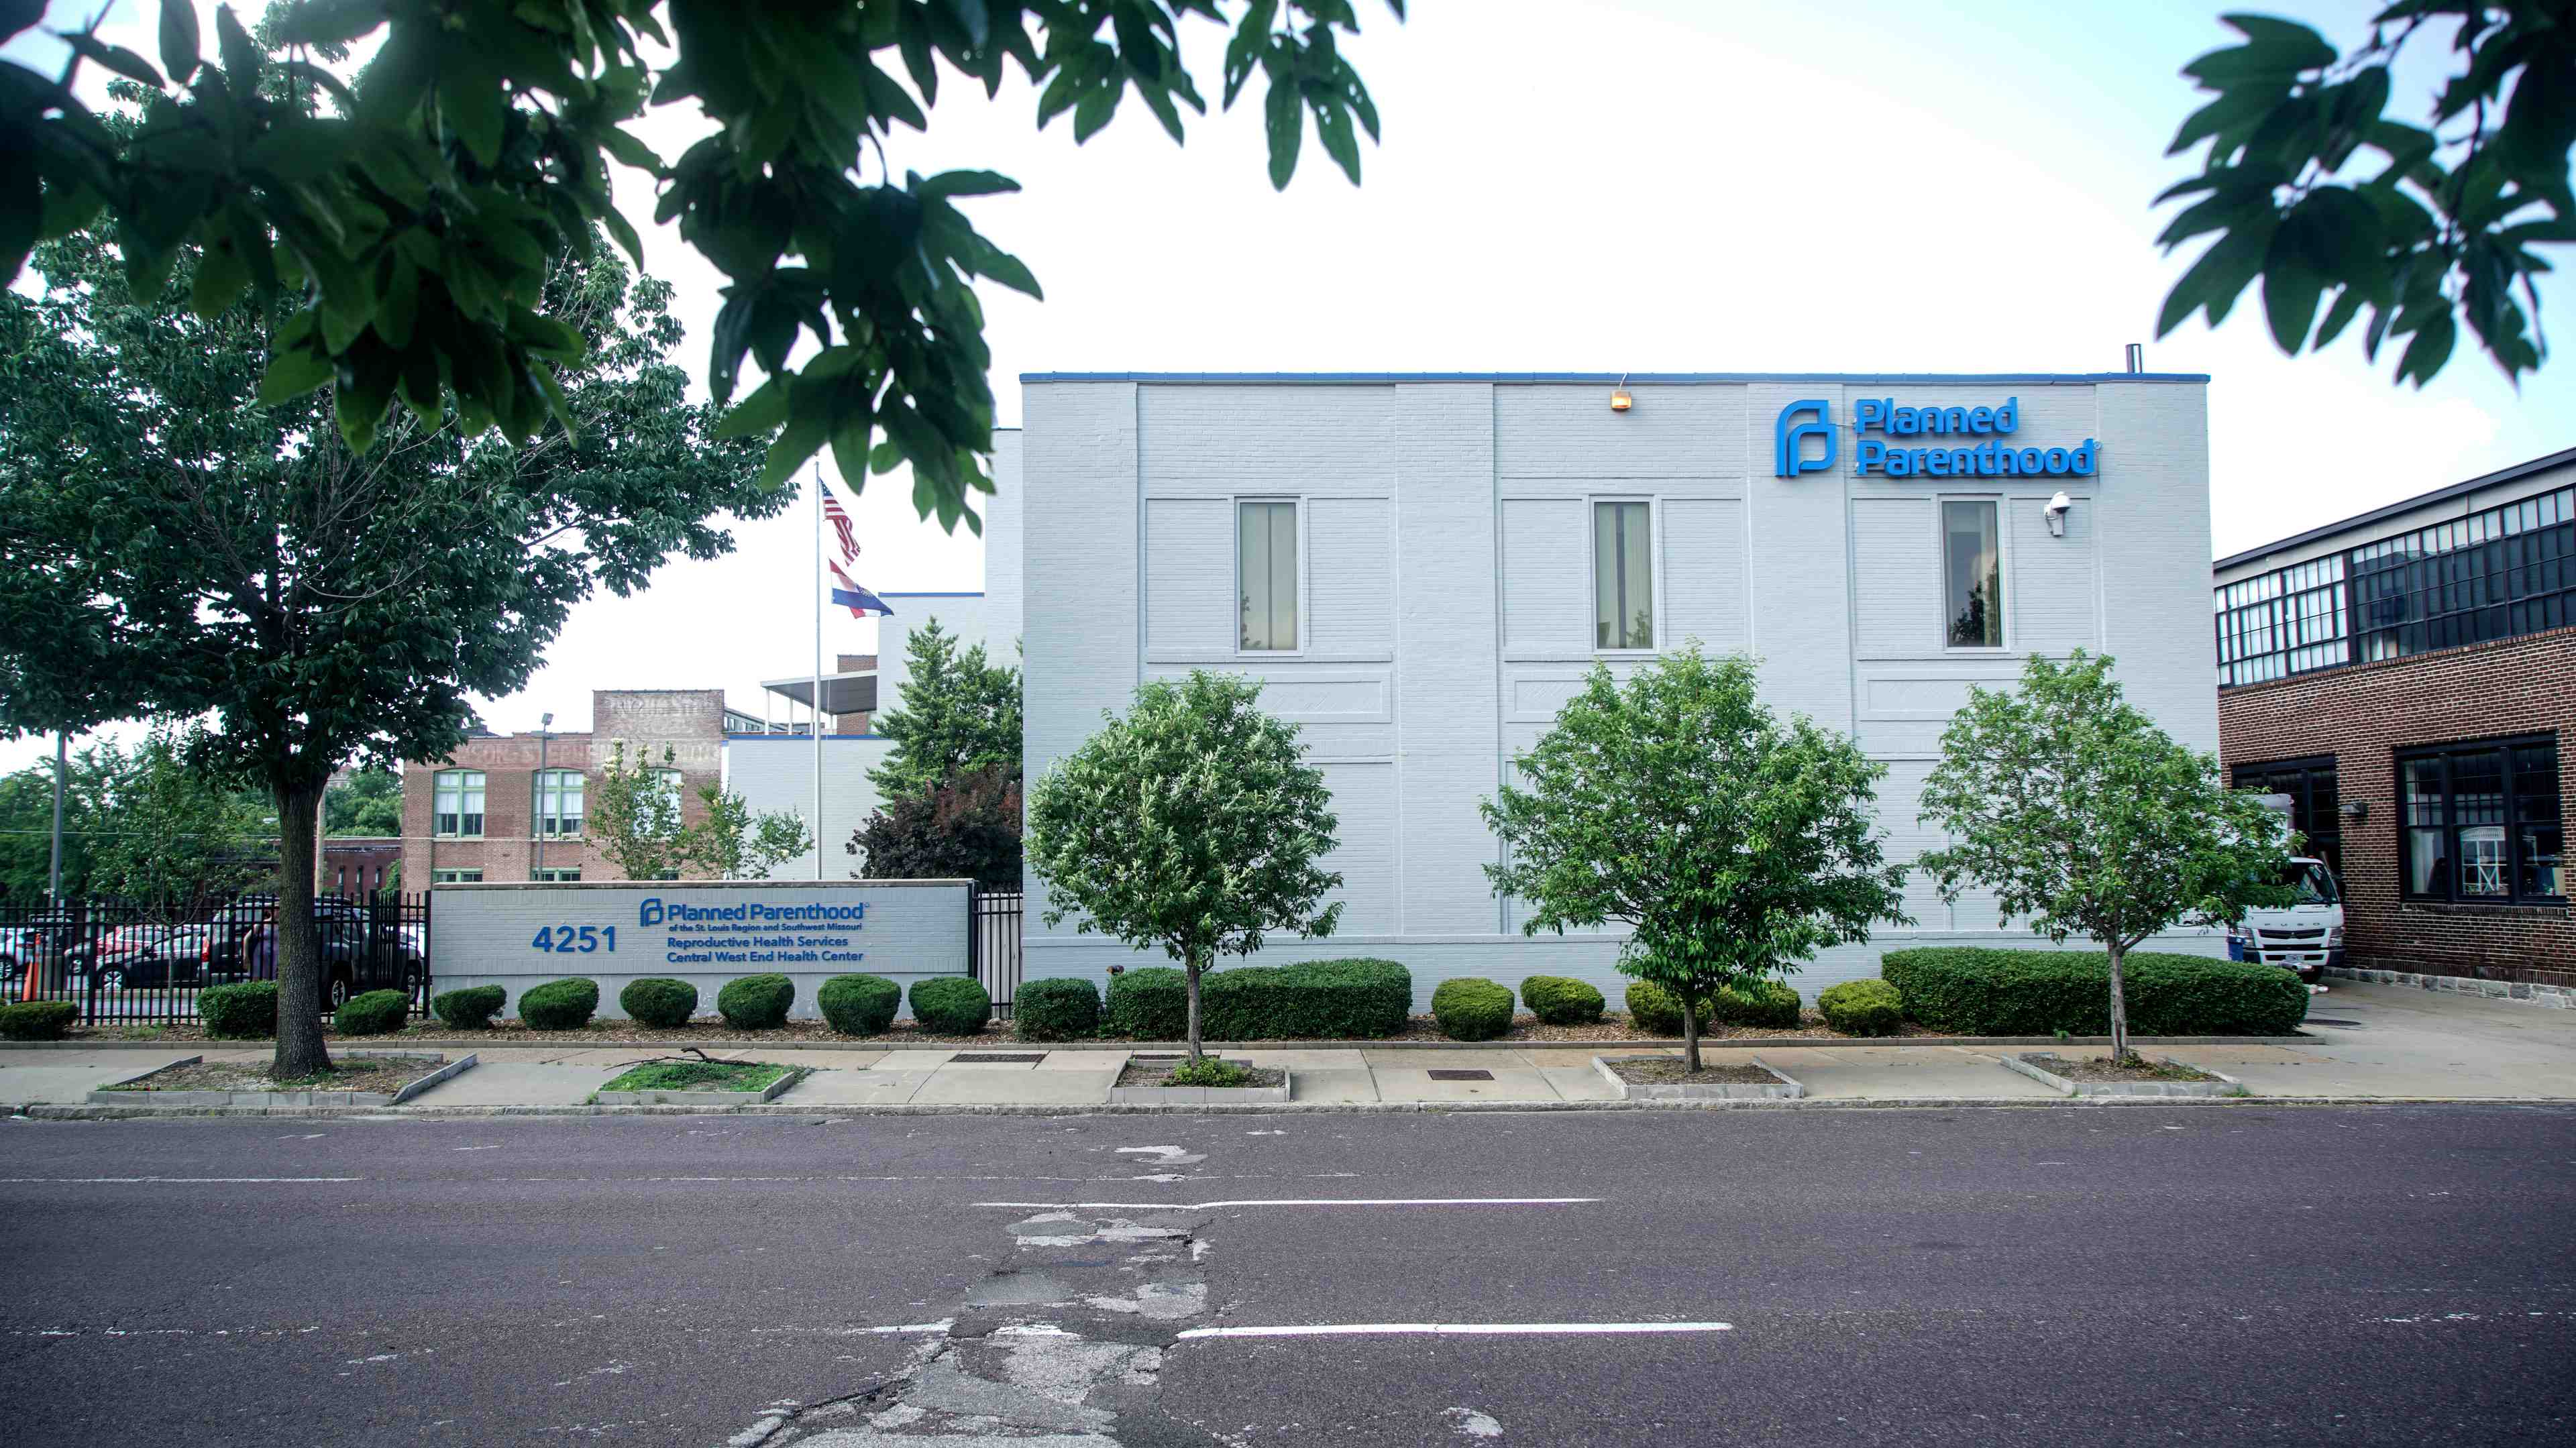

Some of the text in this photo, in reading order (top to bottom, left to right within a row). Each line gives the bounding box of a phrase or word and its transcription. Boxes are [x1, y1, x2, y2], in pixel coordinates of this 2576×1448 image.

[1855, 396, 2018, 435] Planned
[1855, 438, 2096, 477] Parenthood
[666, 903, 864, 921] Planned Parenthood
[732, 924, 761, 933] Region
[782, 923, 825, 931] Southwest
[827, 923, 862, 931] Missouri
[531, 924, 616, 953] 4251
[667, 936, 848, 950] Reproductive Health Services
[667, 950, 864, 962] Central West End Health Center
